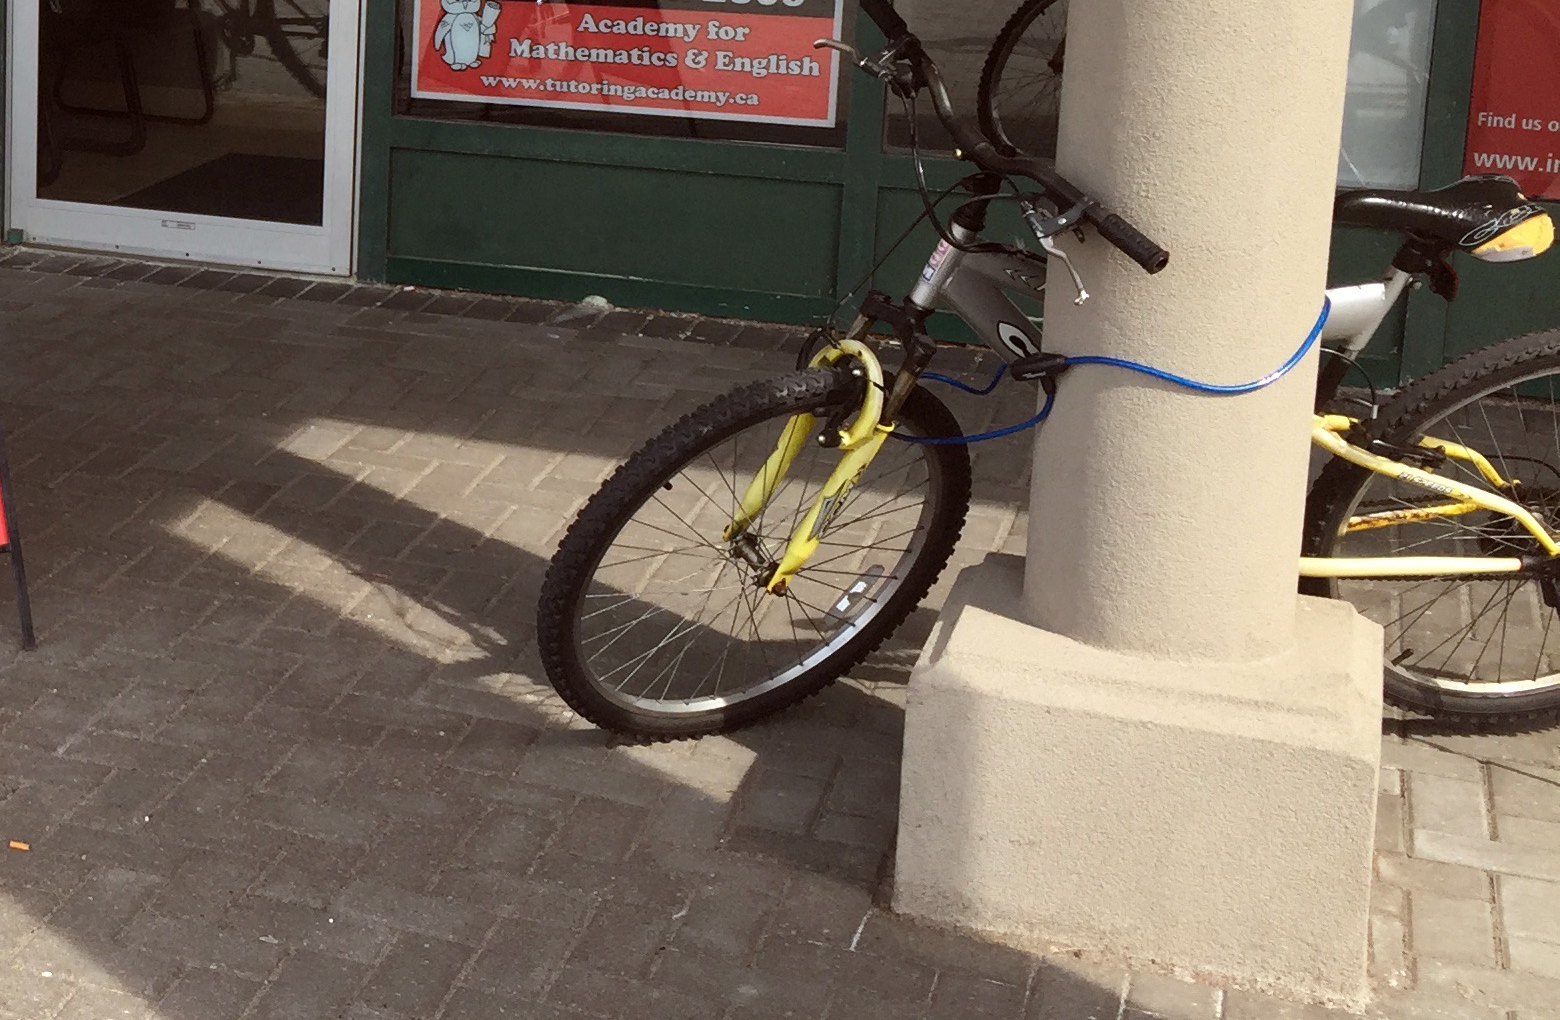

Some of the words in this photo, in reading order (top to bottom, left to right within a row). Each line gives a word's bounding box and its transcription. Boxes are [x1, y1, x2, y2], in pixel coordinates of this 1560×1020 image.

[577, 13, 702, 43] Academy
[707, 20, 750, 42] for
[509, 39, 678, 68] Mathematics
[684, 48, 709, 69] &
[715, 51, 821, 79] English
[481, 73, 760, 106] www.tutoringacademy.ca
[1477, 111, 1517, 129] Find
[1521, 118, 1542, 131] us
